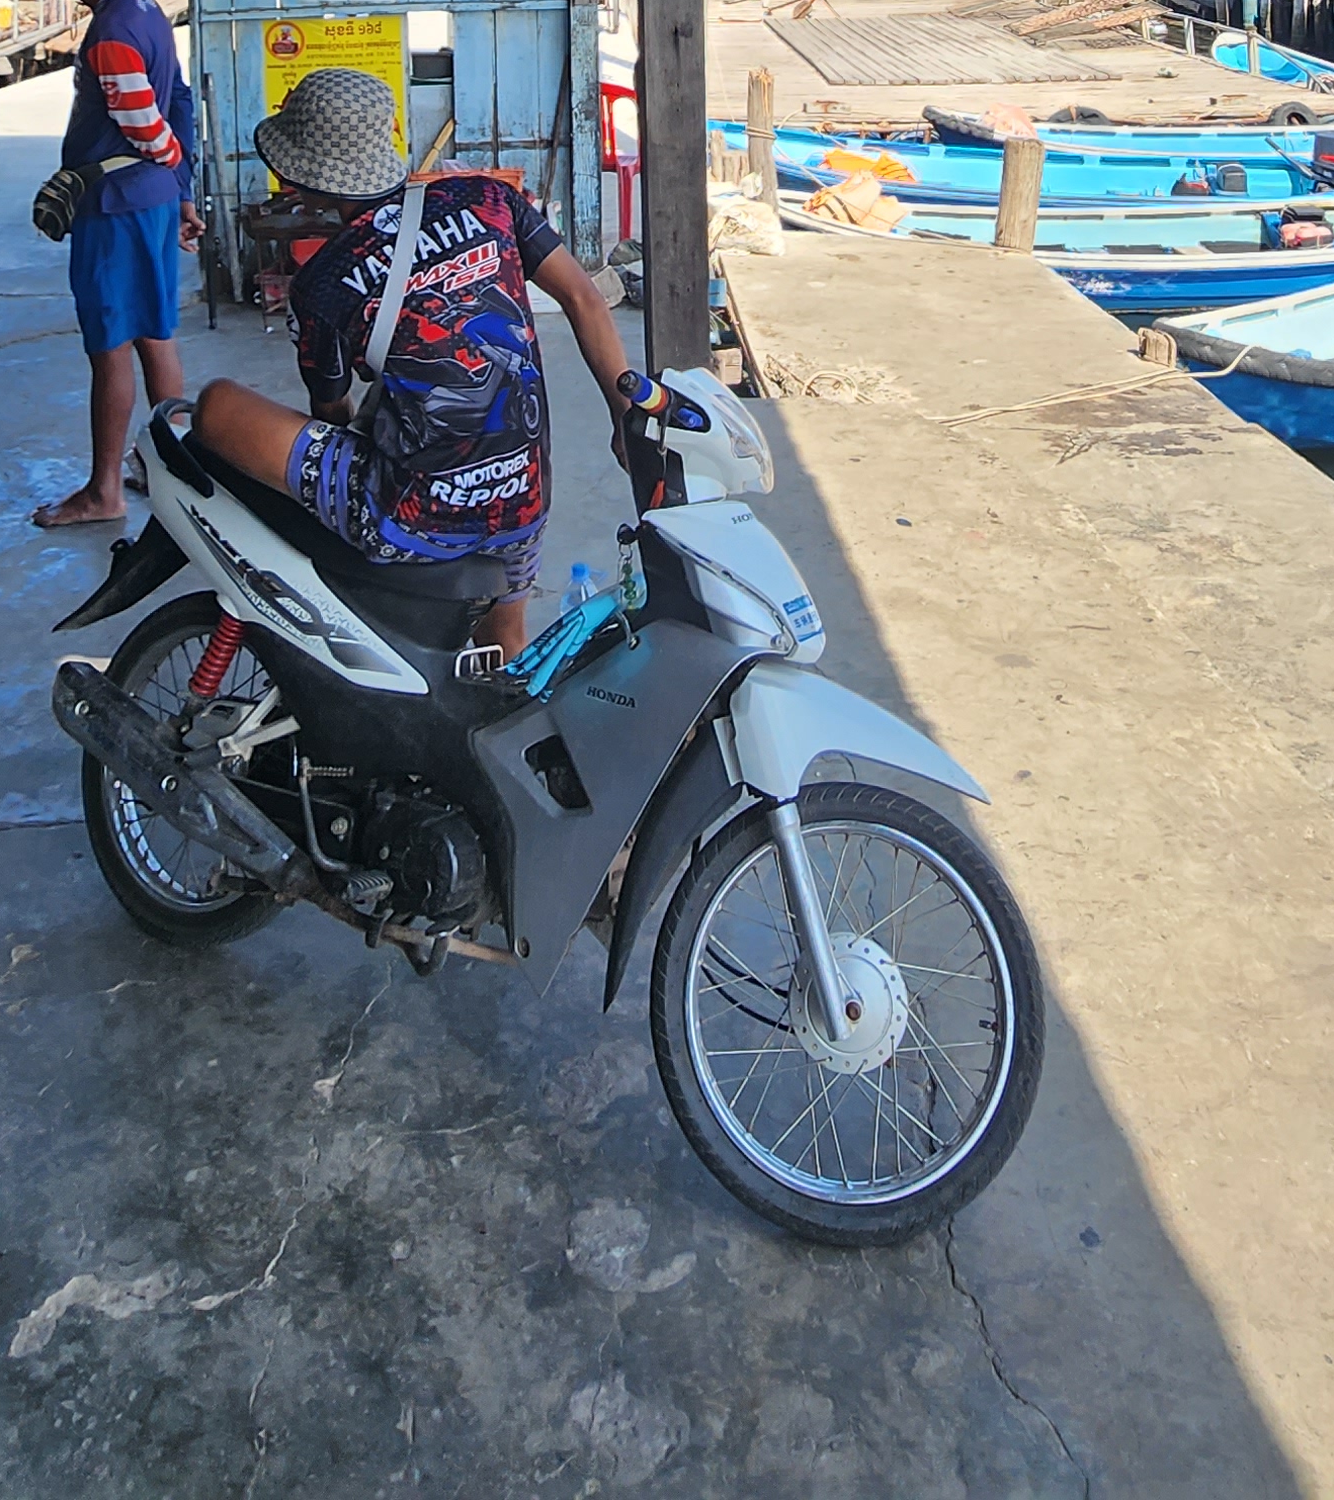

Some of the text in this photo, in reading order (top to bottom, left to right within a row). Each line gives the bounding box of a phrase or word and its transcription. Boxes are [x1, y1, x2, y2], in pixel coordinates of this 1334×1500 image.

[454, 450, 529, 489] MOTOREX
[430, 473, 529, 508] REPSOL
[586, 686, 637, 708] HONDA
